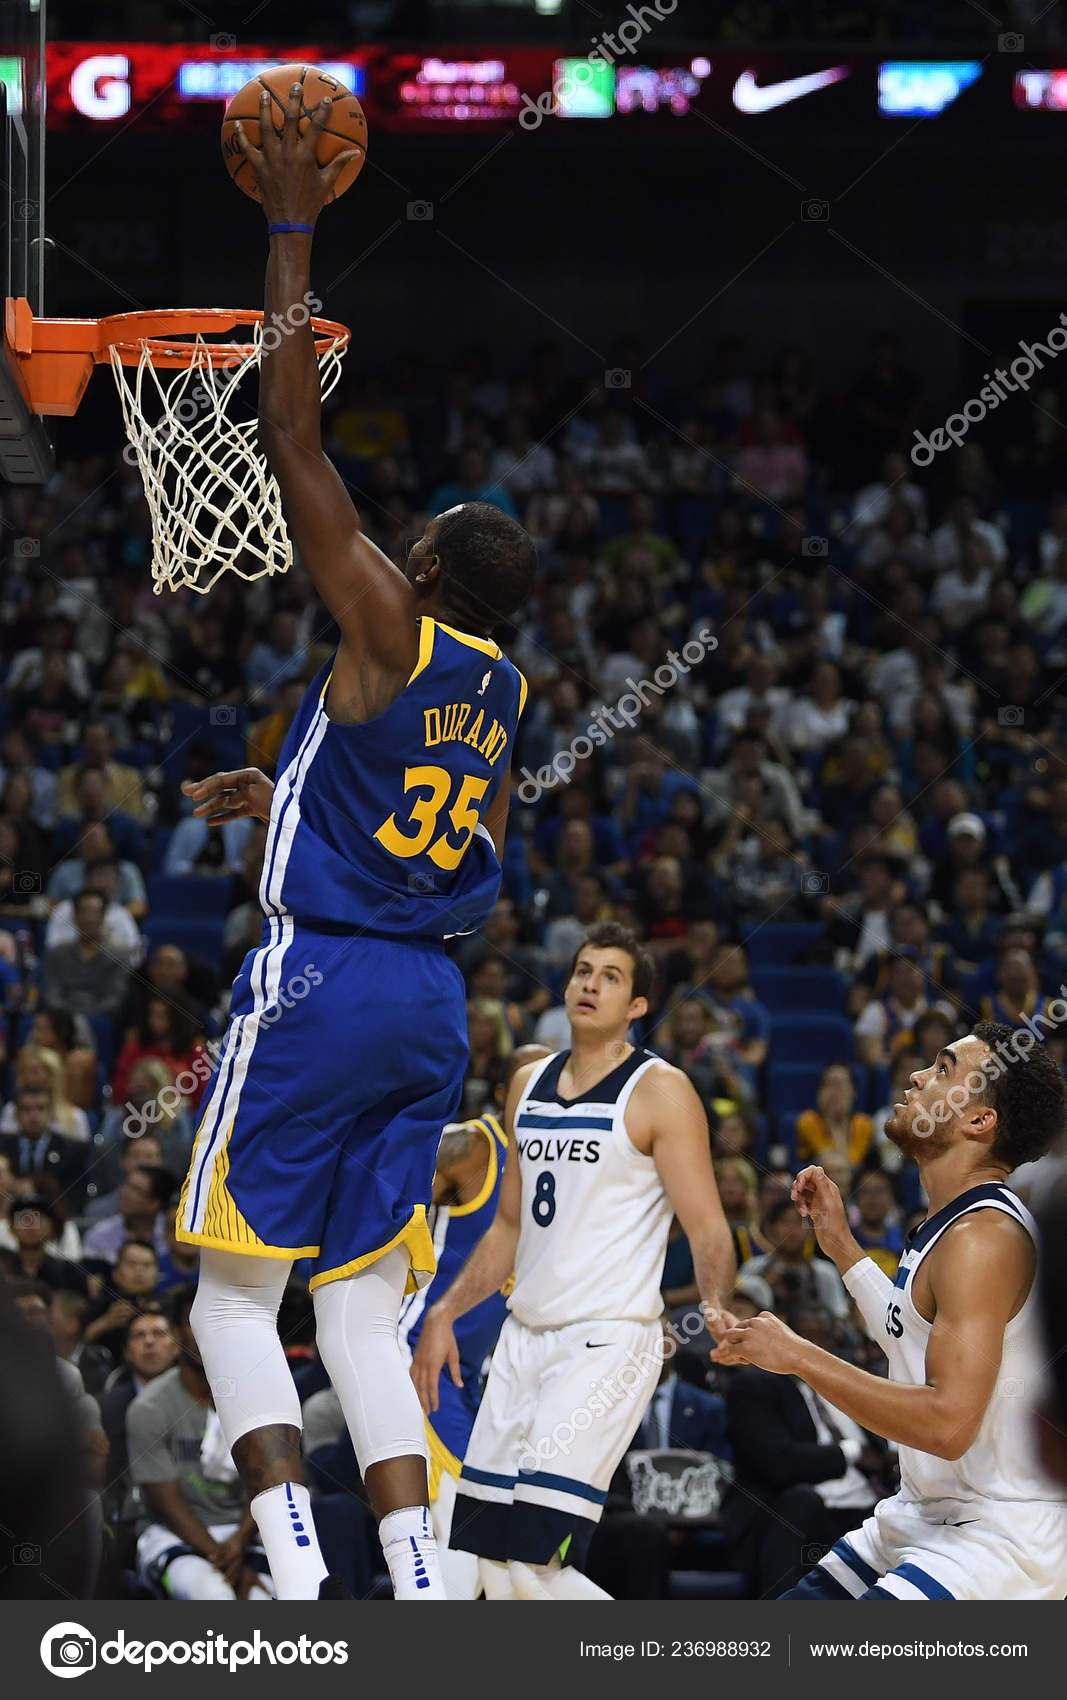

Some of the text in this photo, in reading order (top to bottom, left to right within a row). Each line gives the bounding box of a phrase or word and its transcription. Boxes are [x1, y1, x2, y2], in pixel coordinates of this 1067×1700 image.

[70, 54, 131, 120] G
[423, 703, 507, 766] DURANT
[373, 765, 492, 870] 35
[532, 1171, 556, 1228] 8
